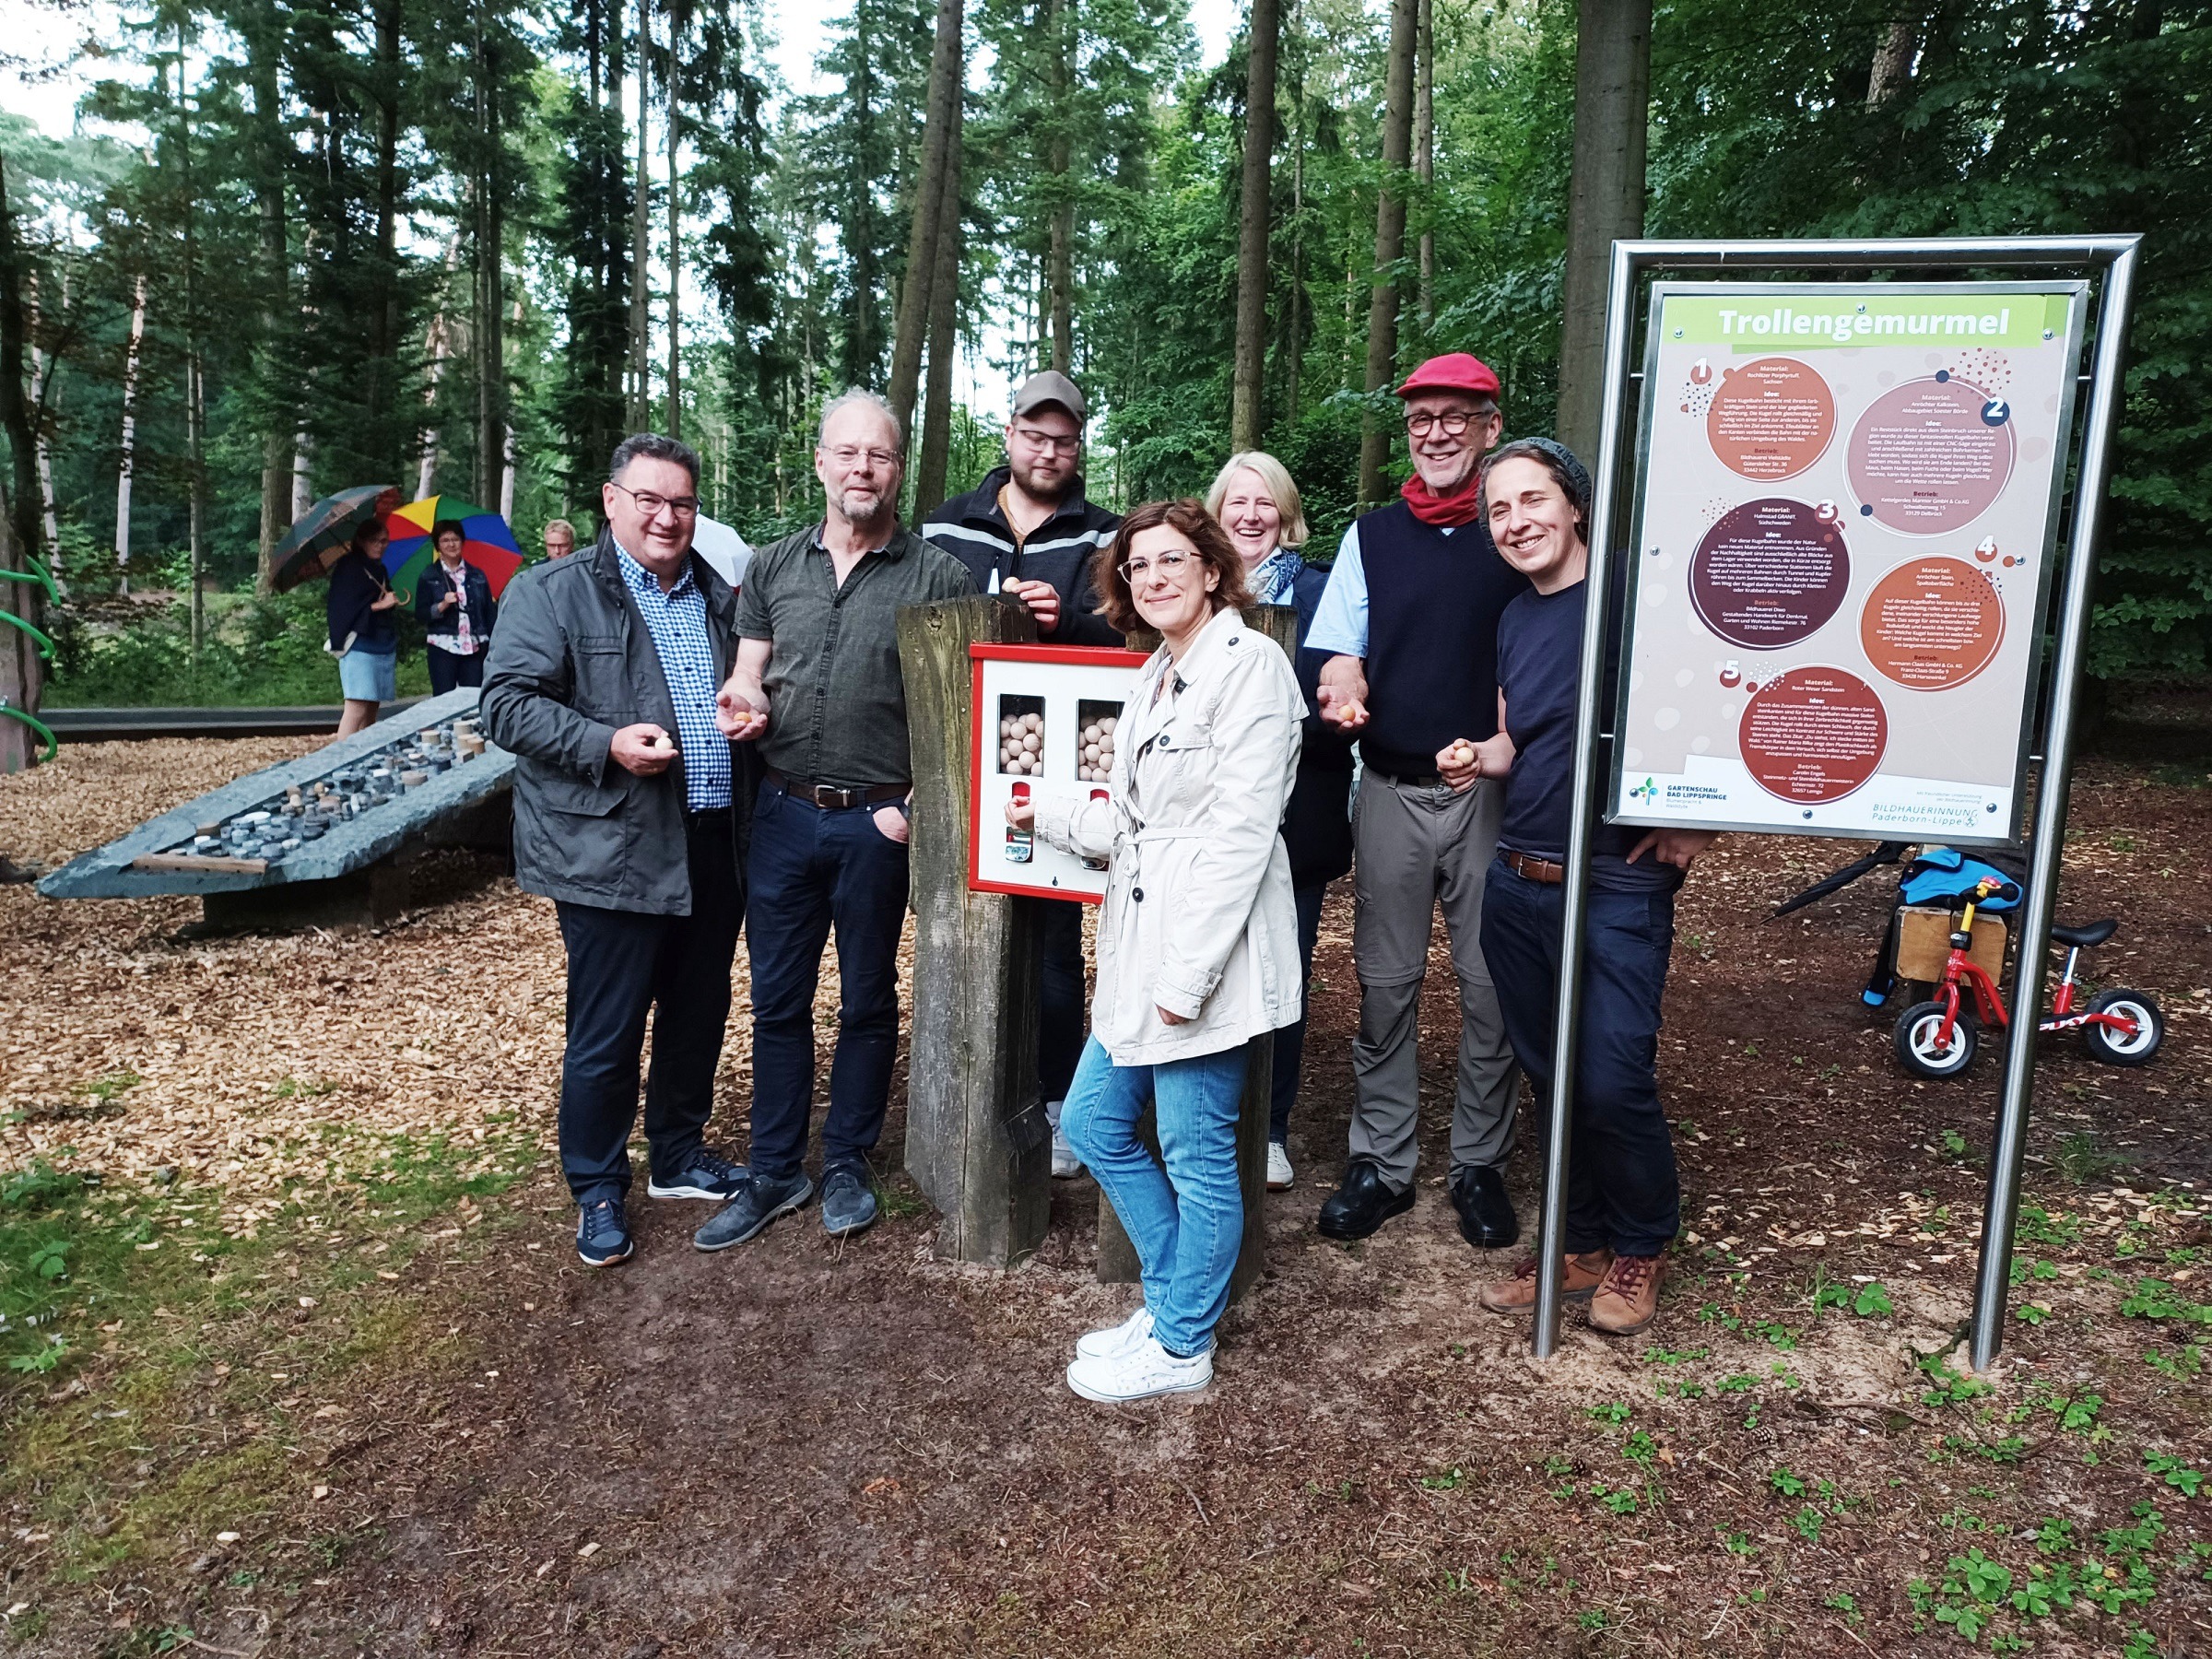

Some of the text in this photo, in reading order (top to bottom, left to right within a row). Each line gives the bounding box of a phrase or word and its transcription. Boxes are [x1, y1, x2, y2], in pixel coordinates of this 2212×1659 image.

[1718, 309, 2009, 341] Trollengemurmel
[1695, 358, 1708, 377] 1
[1987, 396, 2004, 417] 2
[1818, 499, 1834, 518] 3
[1977, 535, 1994, 555] 4
[1724, 660, 1739, 678] 5
[1873, 804, 1978, 817] BILDHAUERINNUNG
[1873, 813, 1961, 826] Paderborn-Lippe
